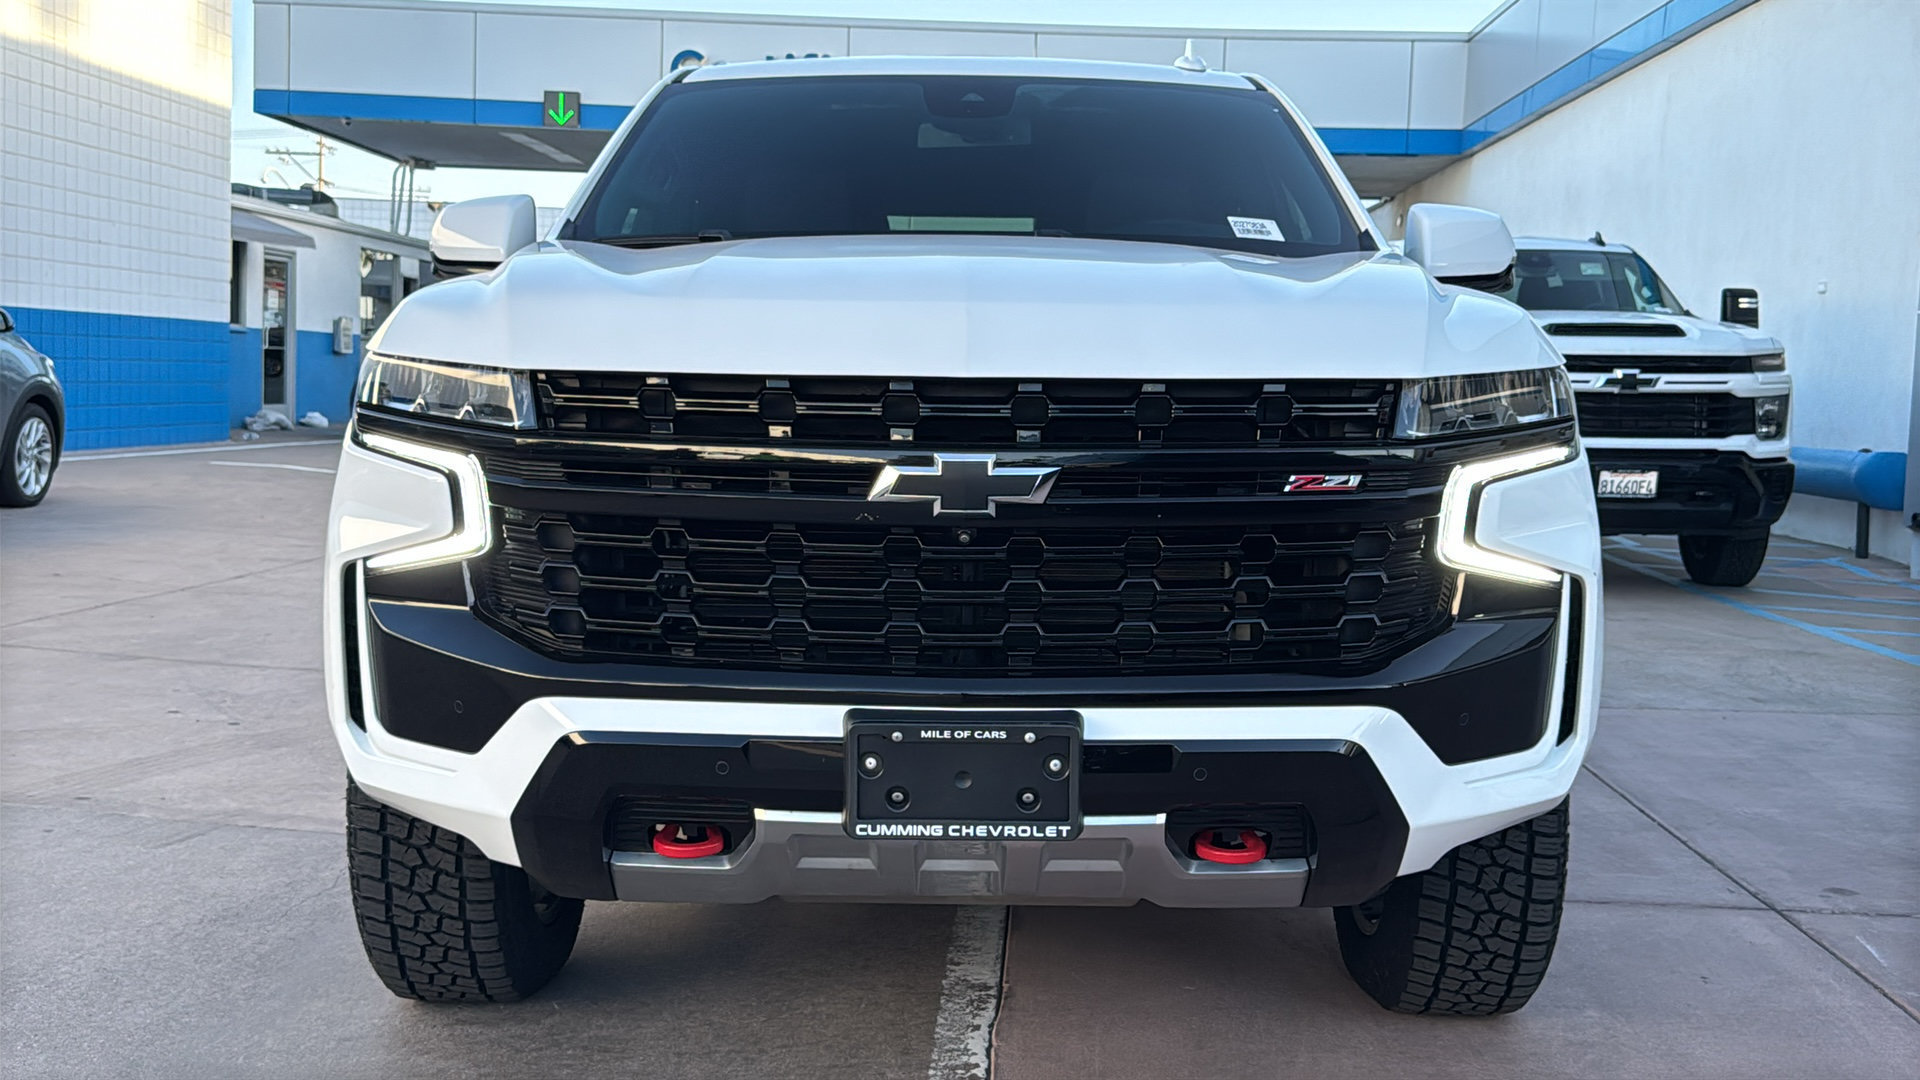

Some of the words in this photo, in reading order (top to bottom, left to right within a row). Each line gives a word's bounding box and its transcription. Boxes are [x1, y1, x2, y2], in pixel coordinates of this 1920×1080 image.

[1284, 475, 1362, 491] Z71
[920, 730, 951, 740] MILE
[953, 730, 971, 740] OF
[974, 730, 1007, 740] CARS
[855, 824, 943, 836] CUMMING
[948, 824, 1071, 837] CHEVROLET
